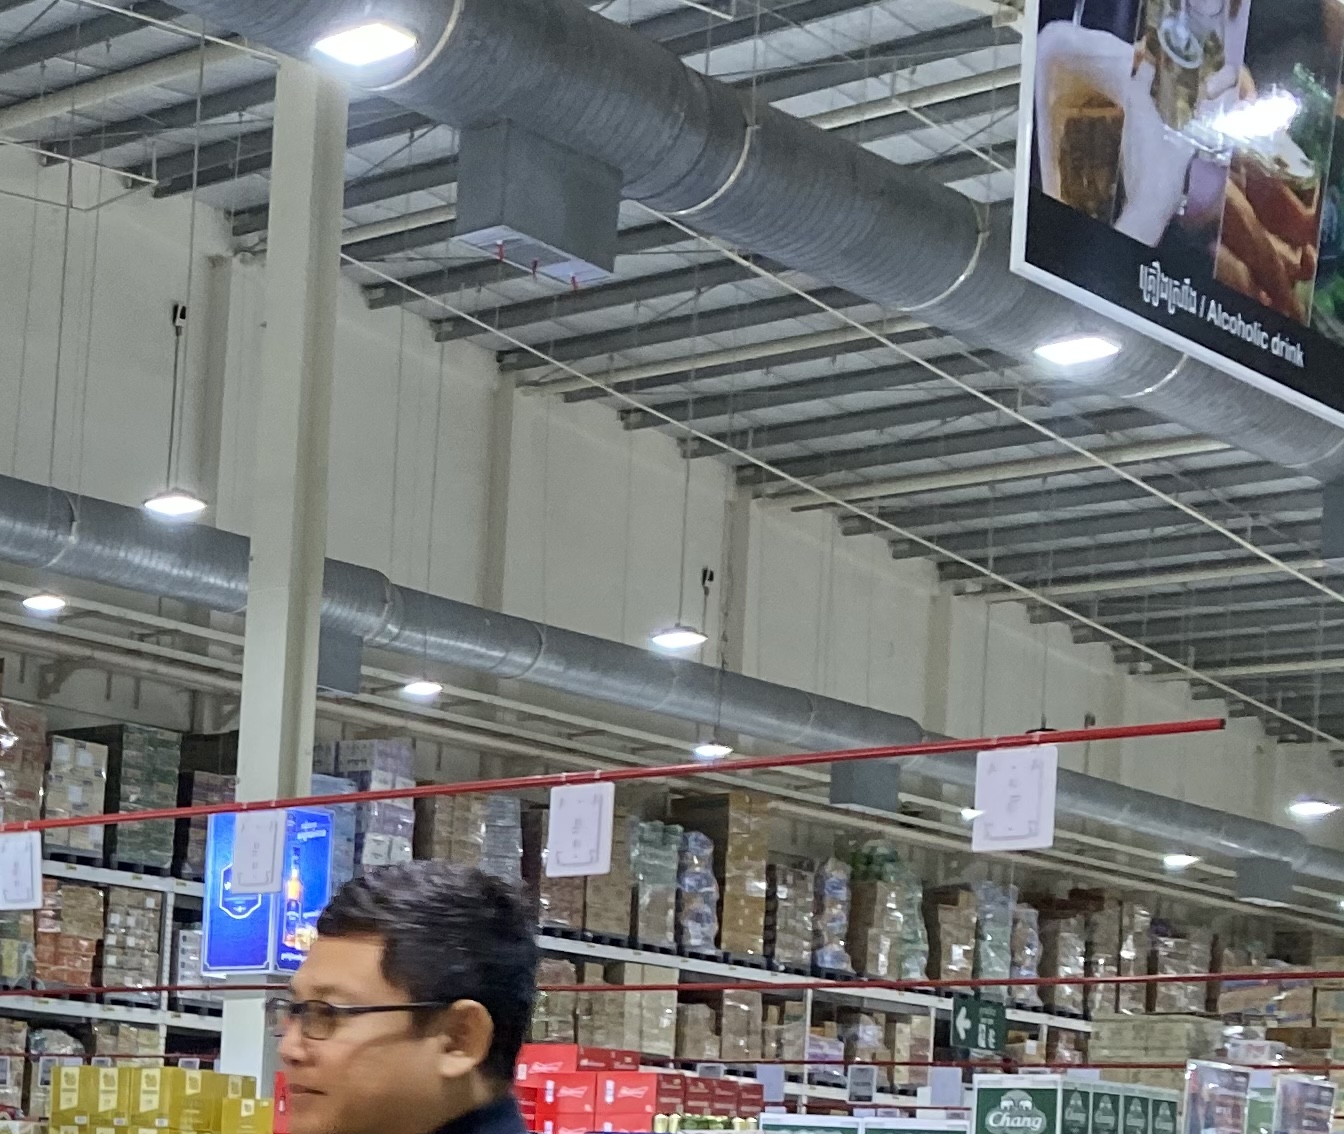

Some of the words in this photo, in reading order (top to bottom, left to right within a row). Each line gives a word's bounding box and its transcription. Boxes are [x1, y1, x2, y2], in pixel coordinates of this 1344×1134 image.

[1207, 299, 1269, 349] Alcoholic
[1271, 333, 1304, 368] drink
[988, 1111, 1043, 1129] Chang
